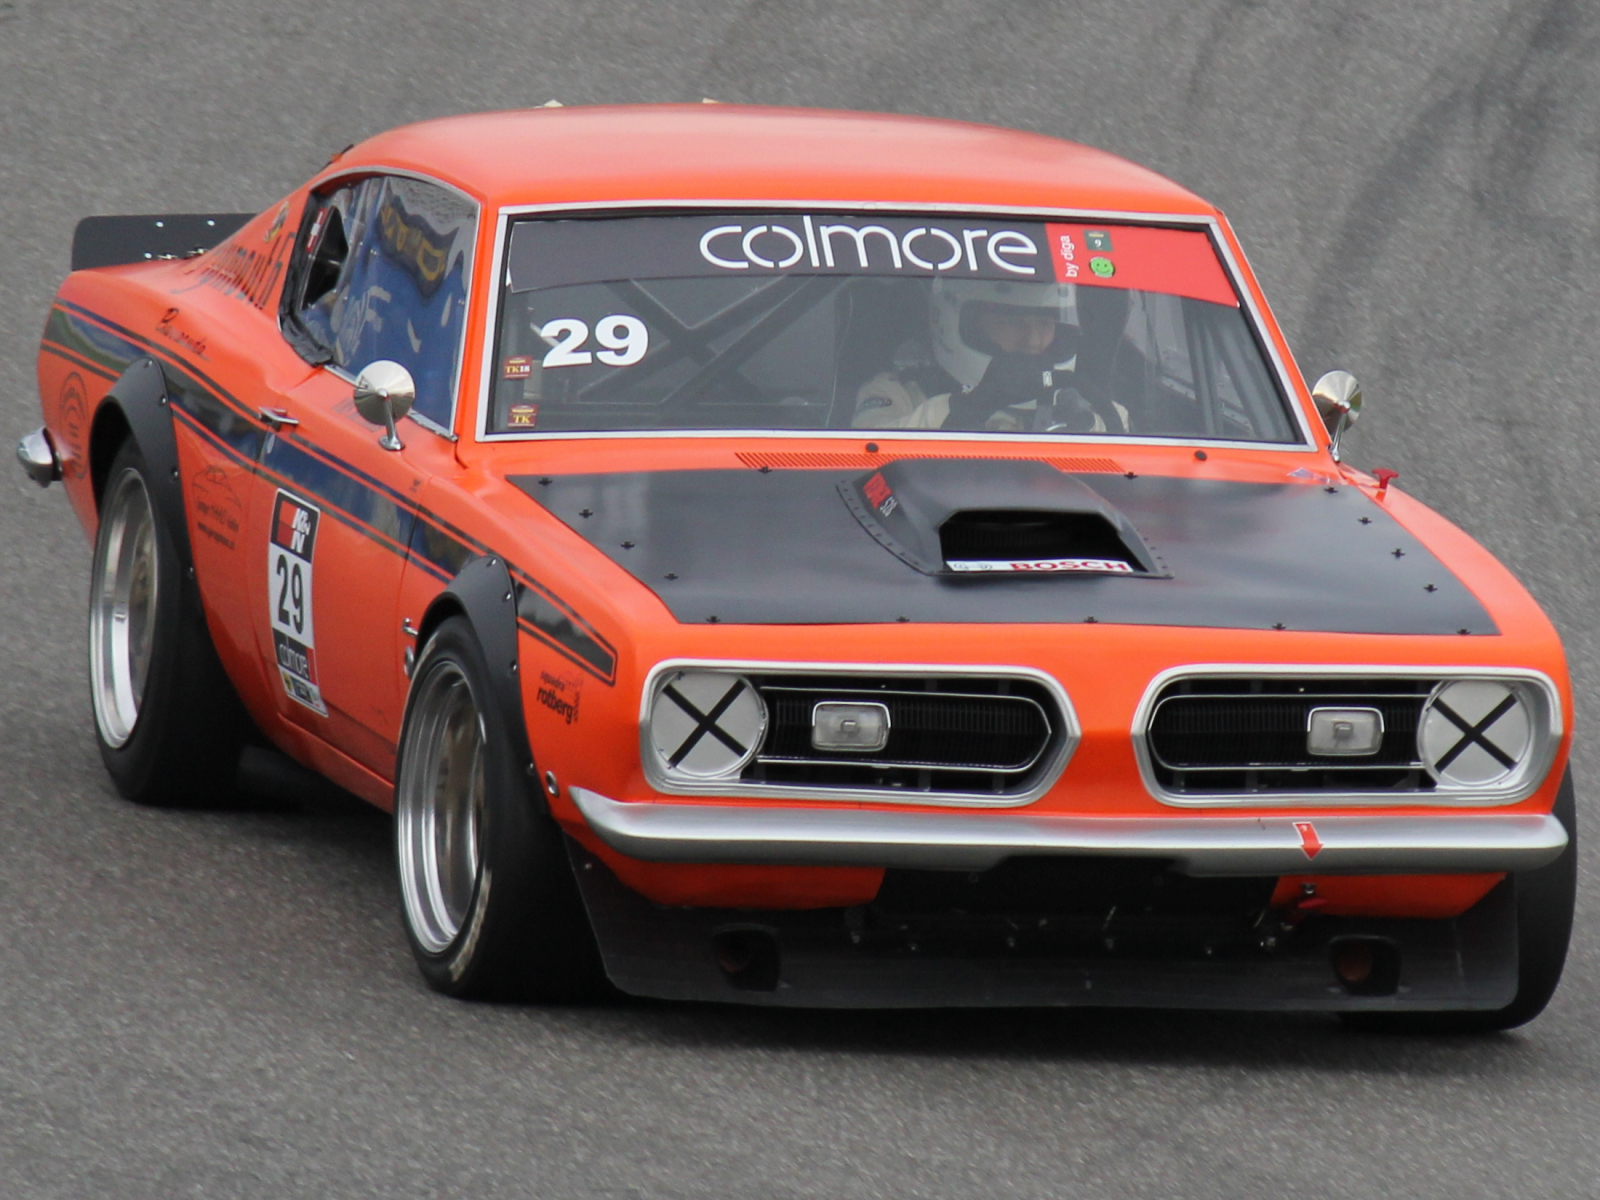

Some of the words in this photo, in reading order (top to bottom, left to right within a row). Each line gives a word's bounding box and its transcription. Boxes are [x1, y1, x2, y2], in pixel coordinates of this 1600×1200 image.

[699, 215, 1038, 275] colmore
[1060, 235, 1075, 261] diga
[1065, 262, 1079, 277] by
[540, 314, 649, 367] 29
[513, 414, 531, 424] TK
[1010, 560, 1128, 572] BOSCH
[276, 554, 304, 635] 29
[537, 687, 573, 725] rotberg
